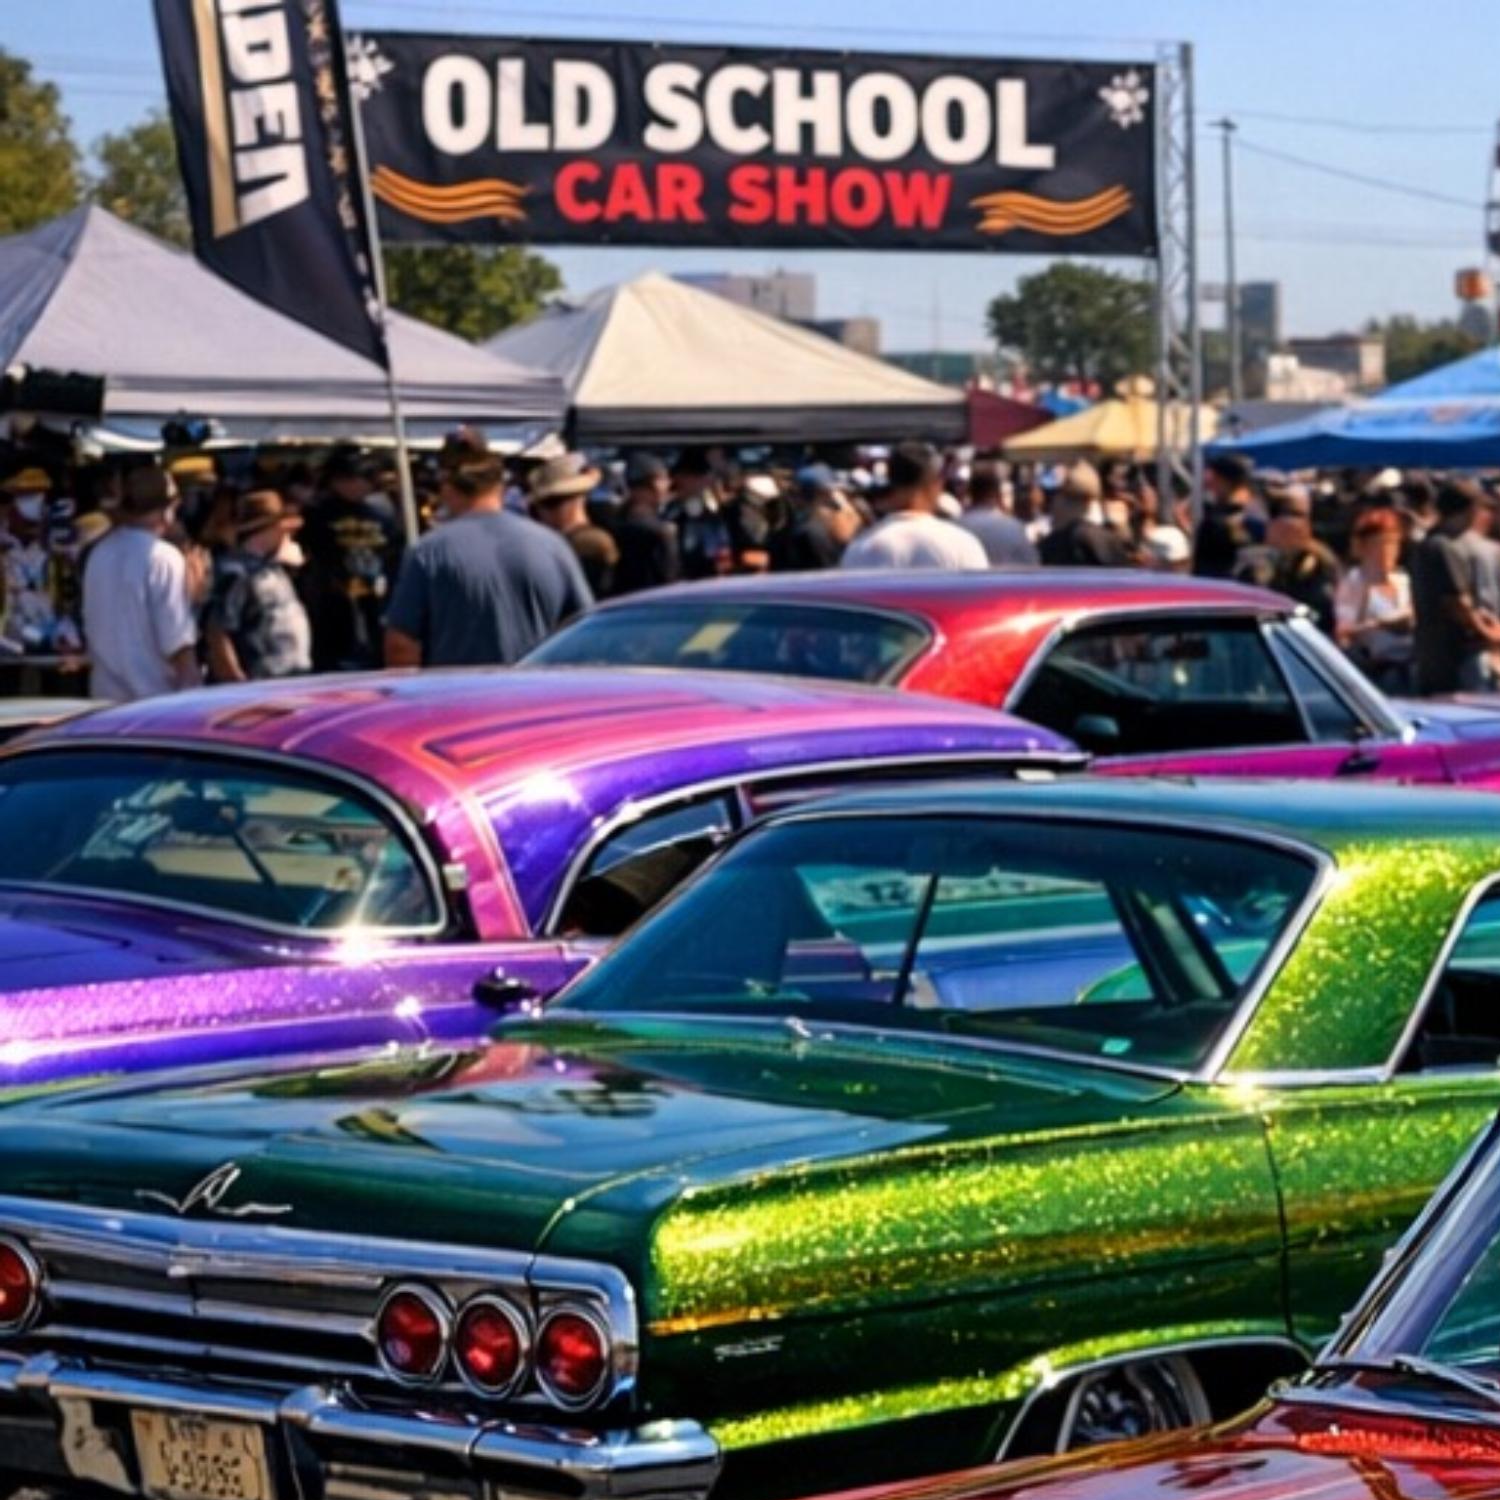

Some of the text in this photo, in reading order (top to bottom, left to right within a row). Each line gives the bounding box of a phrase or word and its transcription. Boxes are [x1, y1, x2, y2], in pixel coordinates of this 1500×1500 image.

[422, 54, 1055, 169] OLD SCHOOL
[553, 162, 952, 230] CAR SHOW
